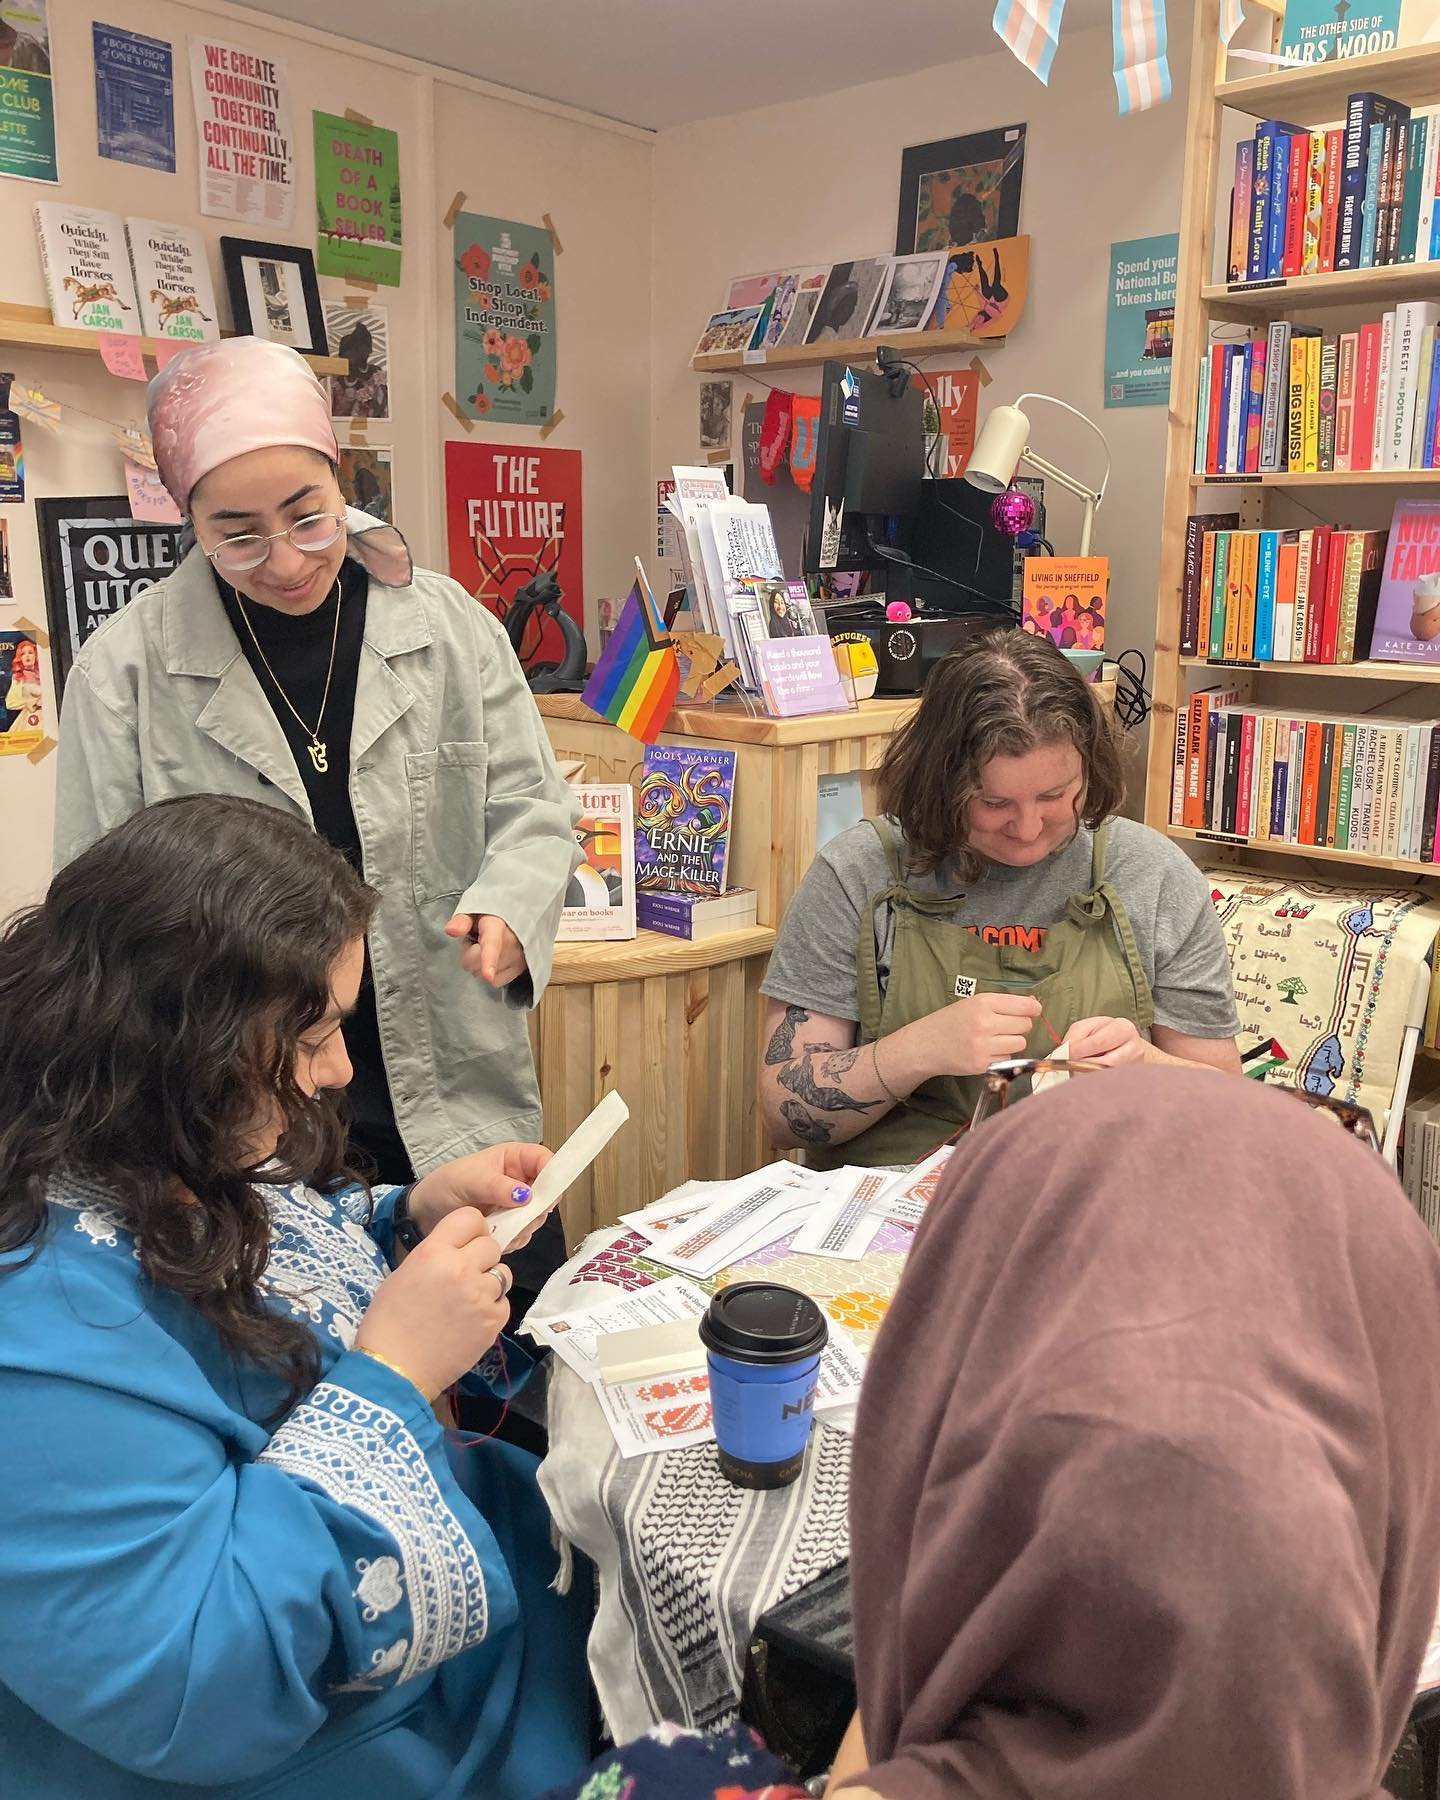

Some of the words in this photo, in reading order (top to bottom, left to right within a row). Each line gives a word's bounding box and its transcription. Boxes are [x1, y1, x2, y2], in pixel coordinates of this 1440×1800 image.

[1300, 27, 1317, 39] THE
[1319, 21, 1347, 36] OTHER
[1350, 18, 1369, 31] SIDE
[1371, 16, 1383, 28] OF
[109, 39, 165, 62] BOOKSHOP
[1284, 40, 1328, 64] MRS
[1336, 30, 1395, 59] WOOD
[204, 46, 228, 70] WE
[230, 48, 276, 83] CREATE
[2, 92, 40, 112] CLUB
[205, 70, 279, 108] COMMUNITY
[212, 97, 280, 135] TOGETHER,
[203, 121, 292, 163] CONTINUALLY,
[1346, 101, 1363, 168] NIGHTBLOOM
[1372, 131, 1381, 147] THE
[207, 147, 230, 172] ALL
[233, 153, 255, 177] THE
[259, 158, 291, 185] TIME.
[331, 140, 383, 169] DEATH
[1261, 136, 1270, 171] Elizabeth
[1369, 149, 1380, 179] ISLAND
[339, 168, 360, 188] OF
[367, 174, 377, 190] A
[1309, 168, 1318, 212] ABULHAWA
[336, 192, 382, 218] BOOK
[1345, 196, 1355, 215] PEACE
[1367, 182, 1378, 211] CHILD
[336, 217, 385, 242] SELLER
[1253, 200, 1265, 235] Family
[1253, 237, 1263, 261] Lore
[1341, 234, 1351, 254] MEDIE
[71, 266, 113, 281] Horses
[1117, 257, 1150, 275] Spend
[1152, 256, 1176, 273] your
[157, 279, 196, 294] Horses
[469, 277, 501, 296] Shop
[506, 283, 542, 302] Local.
[1116, 272, 1160, 291] National
[91, 303, 110, 315] JAN
[491, 297, 523, 316] Shop
[1115, 292, 1152, 307] Tokens
[82, 314, 123, 329] CARSON
[167, 325, 204, 340] CARSON
[175, 315, 192, 327] JAN
[465, 308, 548, 332] Independent.
[1271, 328, 1282, 373] BOOKSHOPS
[1400, 330, 1411, 372] BEREST
[1321, 344, 1335, 390] KILLINGLY
[1292, 384, 1302, 408] BIG
[1393, 392, 1405, 446] POSTCARD
[1290, 411, 1301, 460] SWISS
[493, 455, 540, 494] THE
[467, 499, 565, 538] FUTURE
[1187, 522, 1196, 548] ELIZA
[83, 534, 181, 578] QUE
[1187, 550, 1195, 575] MACE
[1031, 573, 1053, 582] LIVING
[1055, 573, 1062, 582] IN
[1064, 573, 1099, 582] SHEFFIELD
[1299, 556, 1308, 593] RAPTURES
[1297, 595, 1305, 610] JAN
[1344, 542, 1363, 644] CLYTEMNESTRA
[1295, 612, 1303, 642] CARSON
[1385, 641, 1412, 650] KATE
[1193, 699, 1202, 723] ELIZA
[1178, 713, 1186, 737] ELIZA
[1176, 738, 1185, 766] CLARK
[1192, 724, 1201, 754] CLARK
[1342, 732, 1353, 768] EUPHORIA
[1356, 728, 1365, 764] RACHEL
[1367, 729, 1377, 765] RACHEL
[650, 751, 681, 761] JOOLS
[687, 755, 730, 765] WARNER
[1377, 742, 1386, 772] HELPING
[1175, 769, 1183, 786] BOY
[1189, 757, 1199, 798] PENANCE
[1354, 765, 1364, 789] CUSK
[1365, 766, 1374, 790] CUSK
[1376, 774, 1384, 795] HAND
[1391, 763, 1400, 798] CLOTHING
[1174, 788, 1183, 815] PARTS
[1374, 797, 1382, 818] CELIA
[1350, 808, 1359, 838] KUDOS
[1362, 802, 1372, 840] TRANSIT
[1372, 820, 1380, 838] DALE
[1388, 823, 1396, 840] DALE
[651, 828, 711, 854] ERNIE
[635, 861, 720, 883] MAGE-KILLER
[656, 853, 679, 864] AND
[682, 854, 700, 865] THE
[962, 925, 1048, 953] COM
